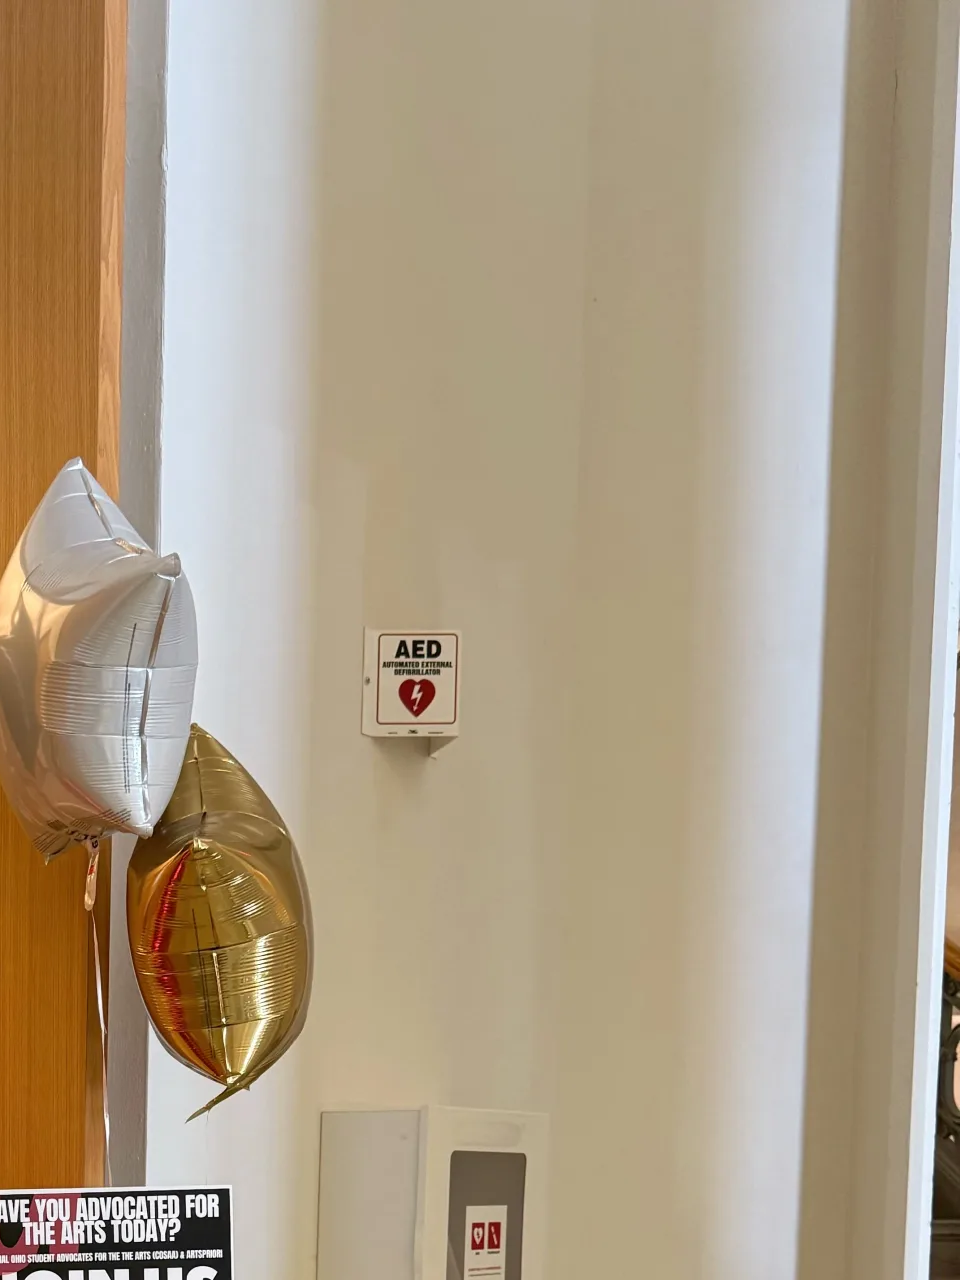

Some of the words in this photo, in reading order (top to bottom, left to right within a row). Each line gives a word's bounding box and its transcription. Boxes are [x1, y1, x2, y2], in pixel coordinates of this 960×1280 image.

[394, 640, 442, 659] AED
[35, 1198, 71, 1222] YOU
[76, 1195, 180, 1221] ADVOCATED
[185, 1194, 220, 1218] FOR
[22, 1221, 56, 1245] THE
[61, 1220, 107, 1244] ARTS
[111, 1218, 181, 1243] TODAY?
[11, 1254, 26, 1263] OHIO
[27, 1253, 54, 1263] STUDENT
[56, 1253, 93, 1262] ADVOCATES
[95, 1252, 107, 1261] FOR
[108, 1252, 120, 1261] THE
[121, 1251, 133, 1260] THE
[134, 1251, 151, 1260] ARTS
[152, 1250, 179, 1260] (COSAA)
[180, 1251, 185, 1259] &
[186, 1249, 223, 1259] ARTSPRIORI
